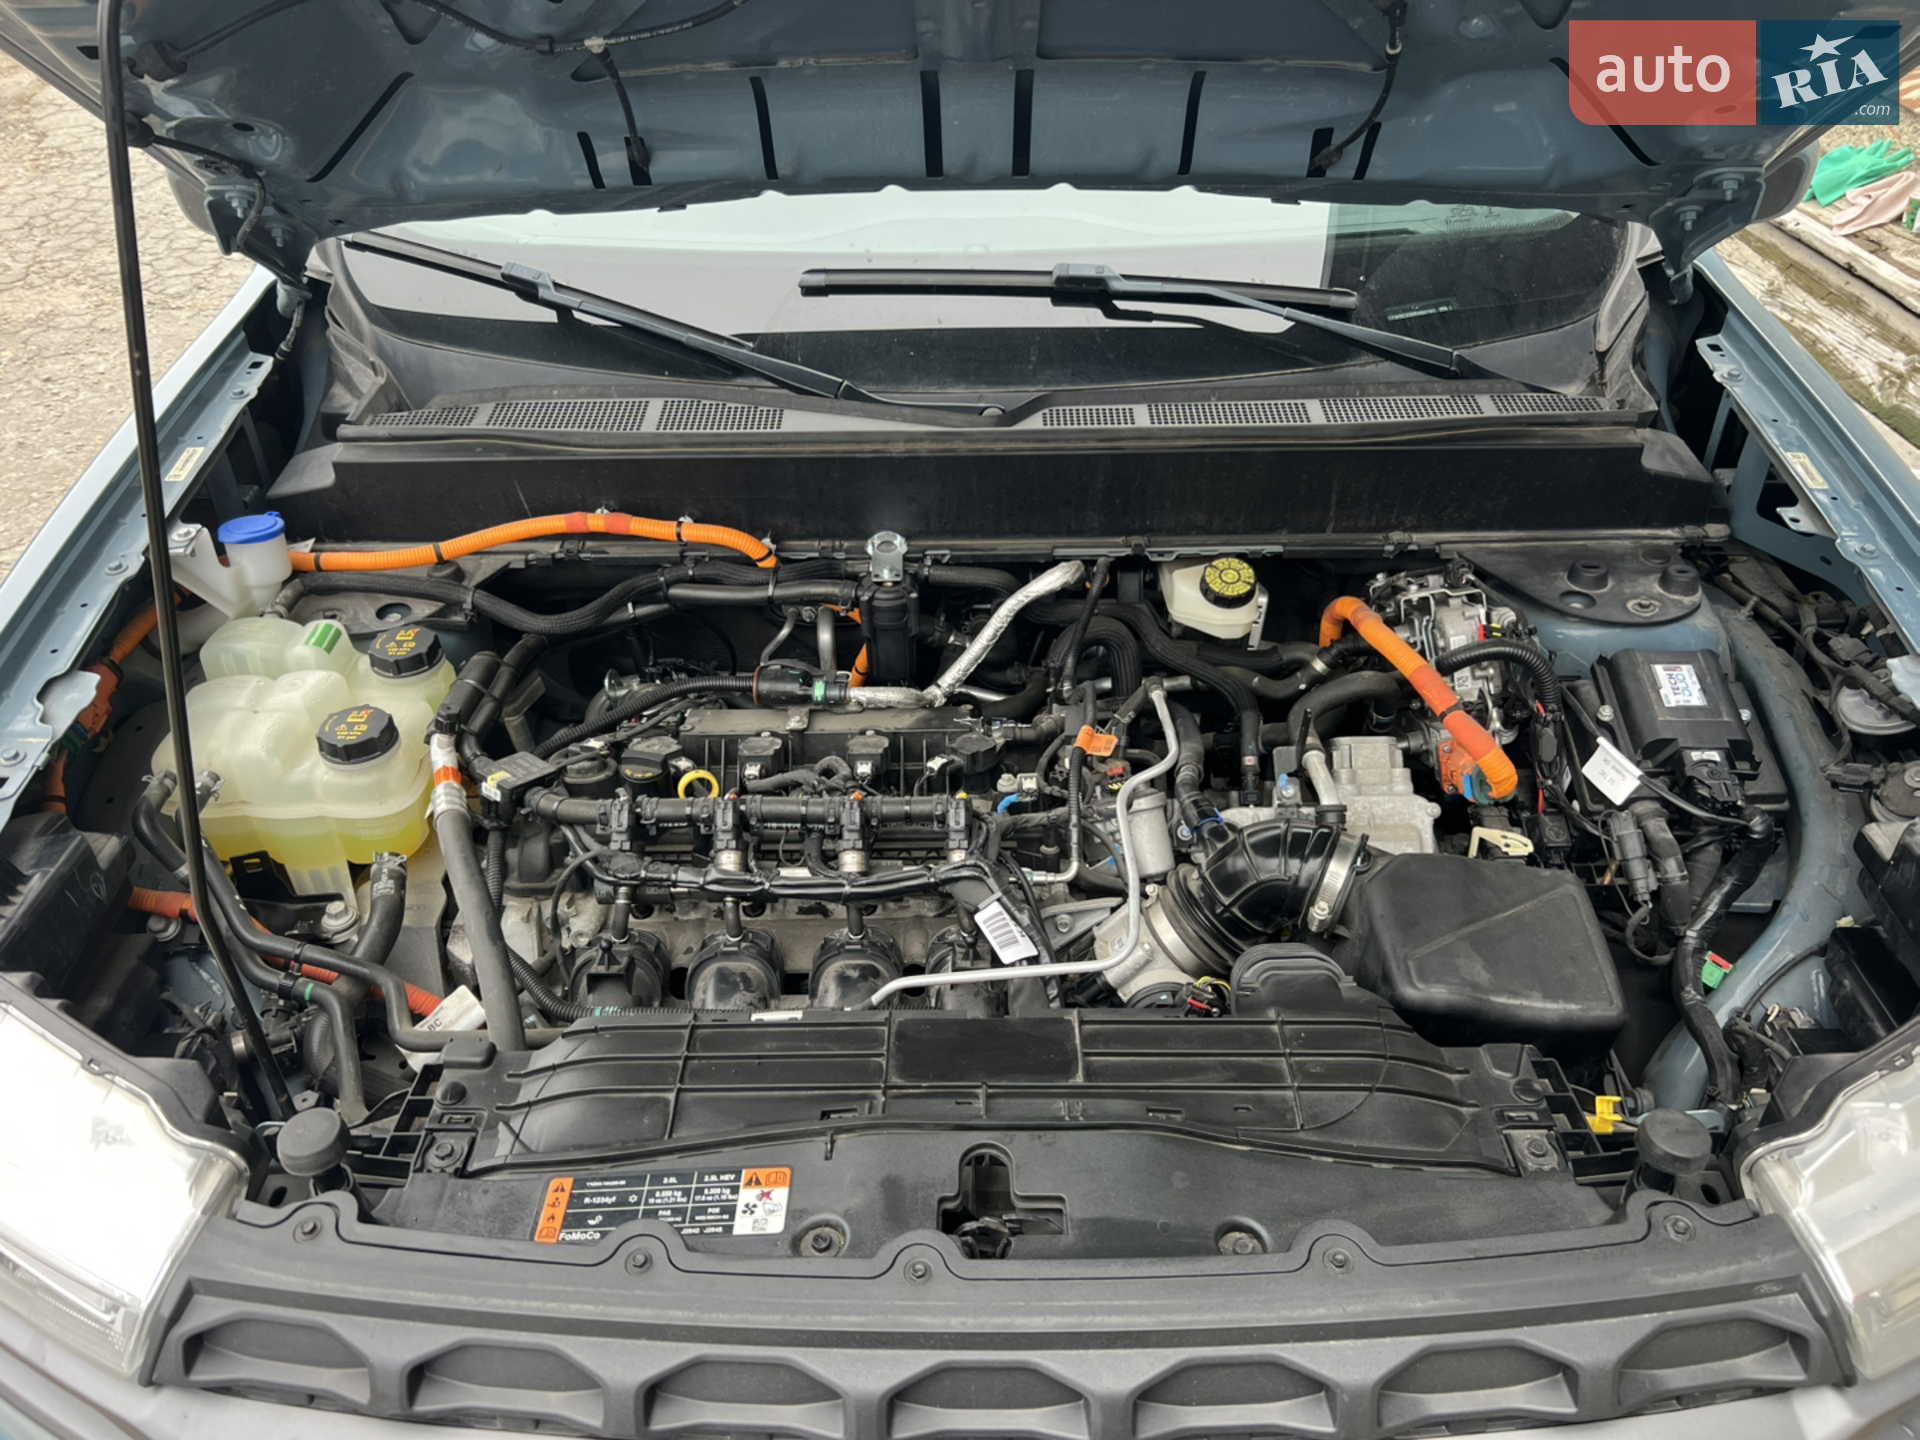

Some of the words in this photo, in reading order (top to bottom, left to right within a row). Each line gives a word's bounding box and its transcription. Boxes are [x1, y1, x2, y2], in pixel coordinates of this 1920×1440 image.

[1666, 673, 1682, 696] TECH
[719, 1173, 736, 1181] HEV
[583, 1196, 617, 1204] R-1234yf
[559, 1231, 601, 1242] FoMoCo
